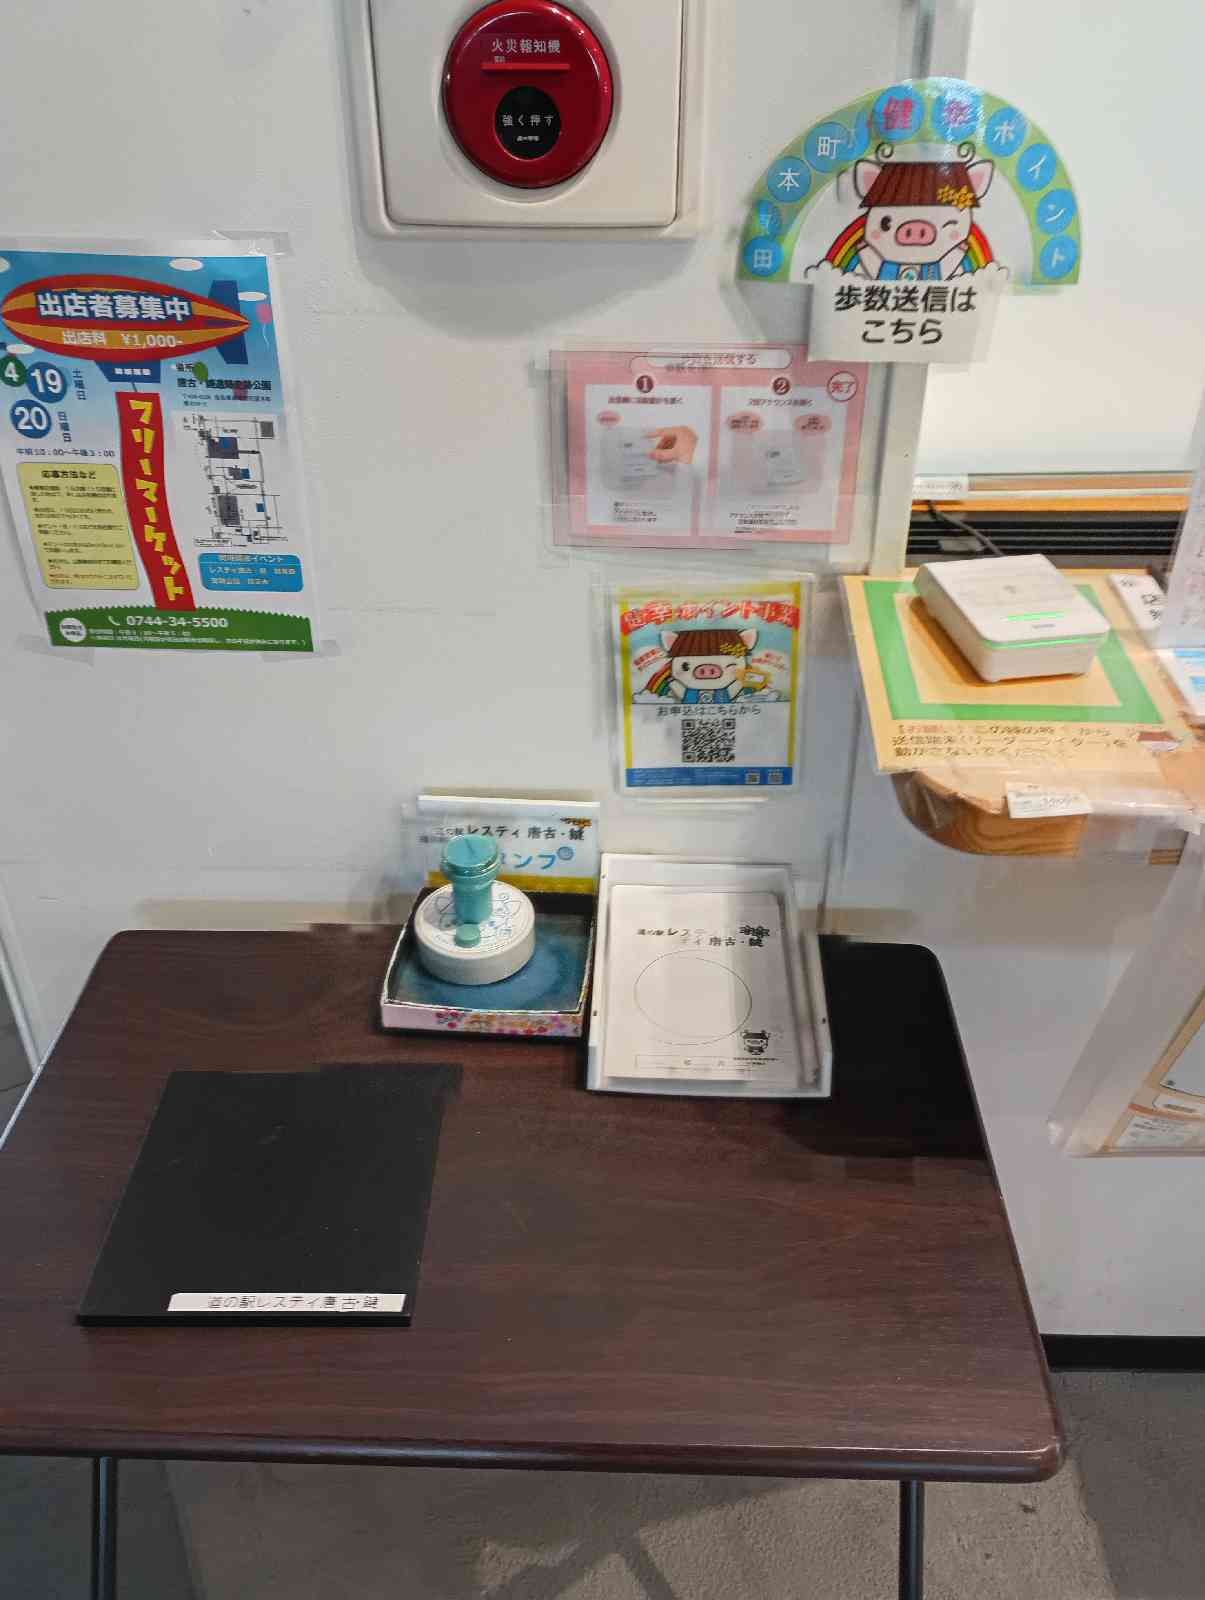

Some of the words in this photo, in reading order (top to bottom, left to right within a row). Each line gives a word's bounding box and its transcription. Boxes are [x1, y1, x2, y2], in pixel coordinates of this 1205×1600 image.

[491, 38, 561, 54] 火災報知機
[502, 114, 554, 127] 強く押す
[37, 292, 191, 321] 出店者募集中
[834, 286, 977, 313] 歩数送信は
[63, 329, 107, 345] 出店料
[861, 319, 943, 344] こちら
[4, 362, 20, 382] 4
[31, 368, 62, 394] 19
[15, 406, 48, 430] 20
[128, 399, 184, 601] フリーマーケット
[126, 616, 229, 628] 0744-34-5500
